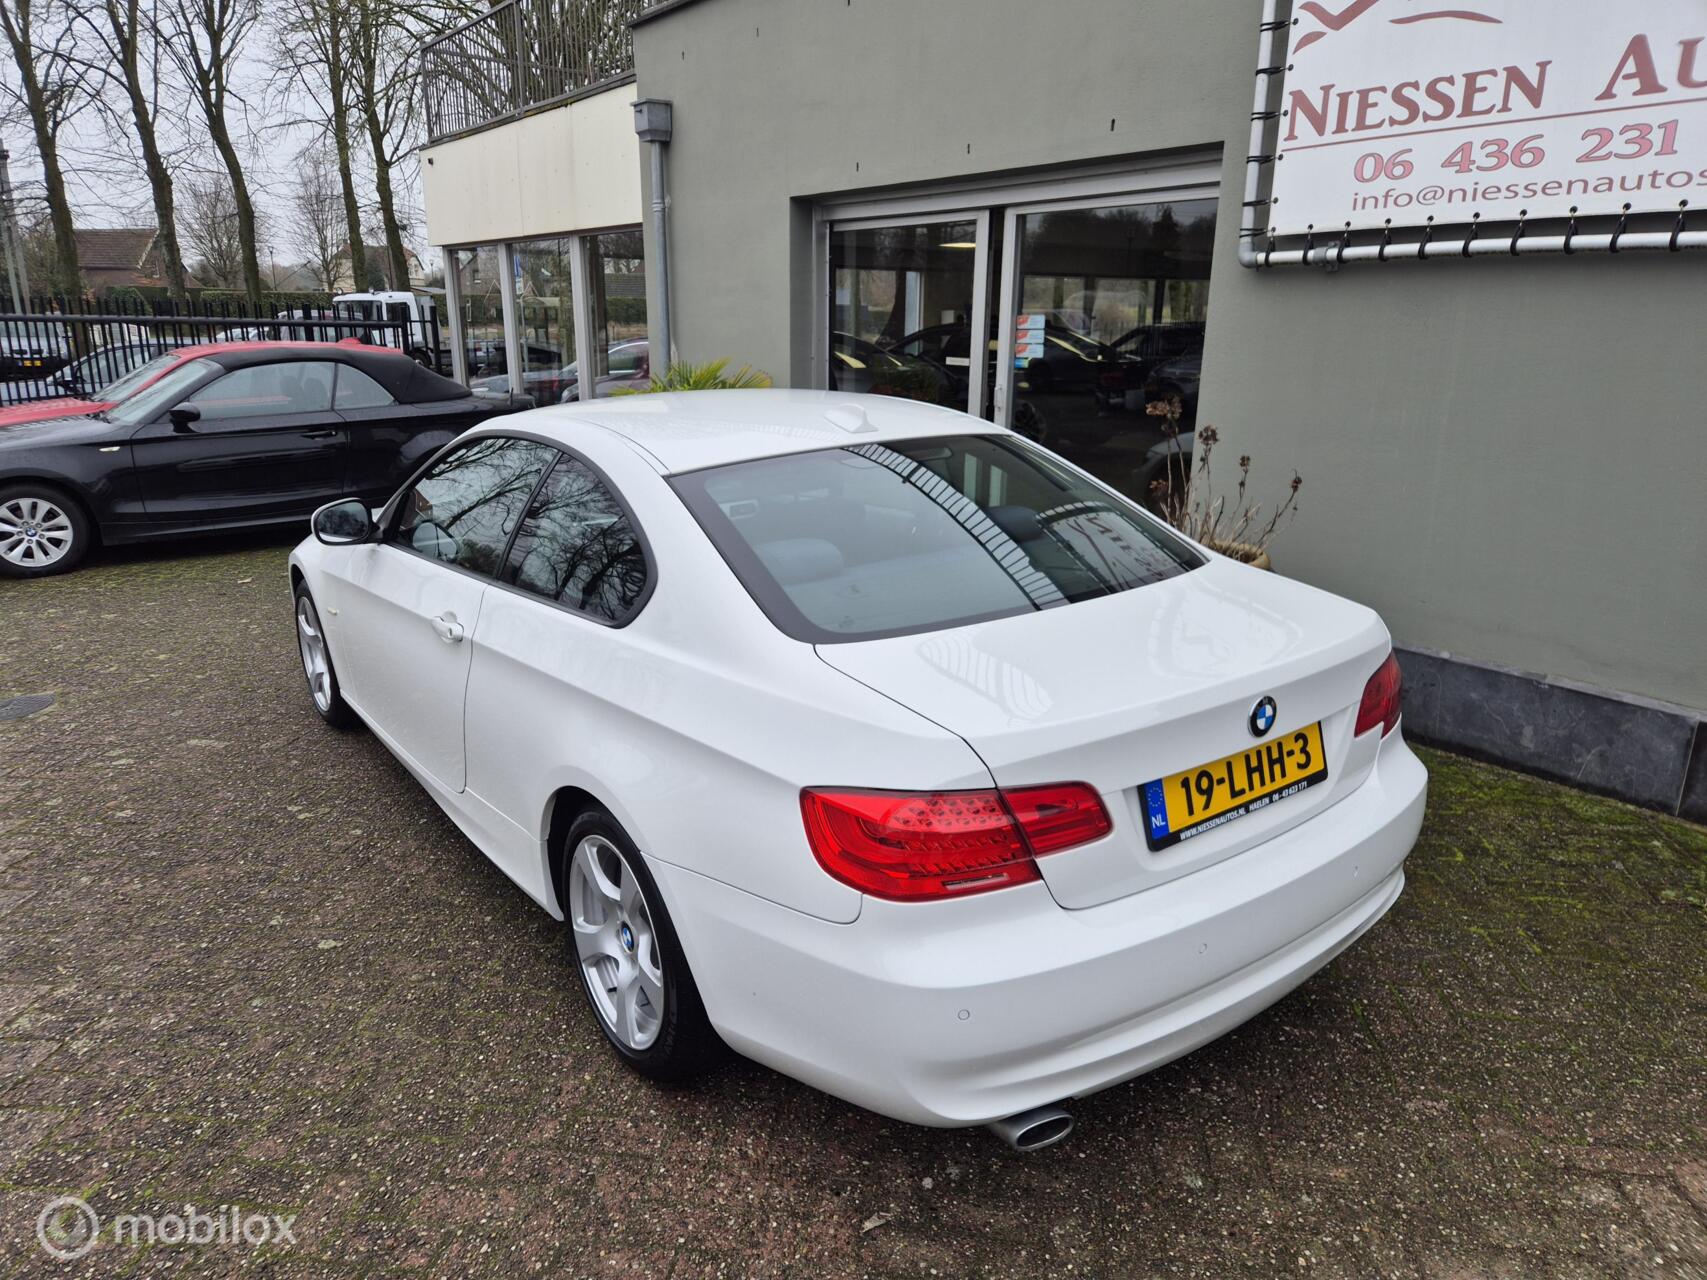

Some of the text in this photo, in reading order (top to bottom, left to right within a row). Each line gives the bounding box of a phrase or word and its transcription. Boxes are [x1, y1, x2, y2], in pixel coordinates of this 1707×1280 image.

[1284, 60, 1552, 141] NIESSEN
[1353, 119, 1679, 183] 06 436 231
[1180, 732, 1312, 817] 19-LHH-3
[1151, 814, 1166, 828] NL
[1180, 807, 1246, 841] WWW.NIESSENAUTOS.NL
[1249, 797, 1270, 812] HAELEN
